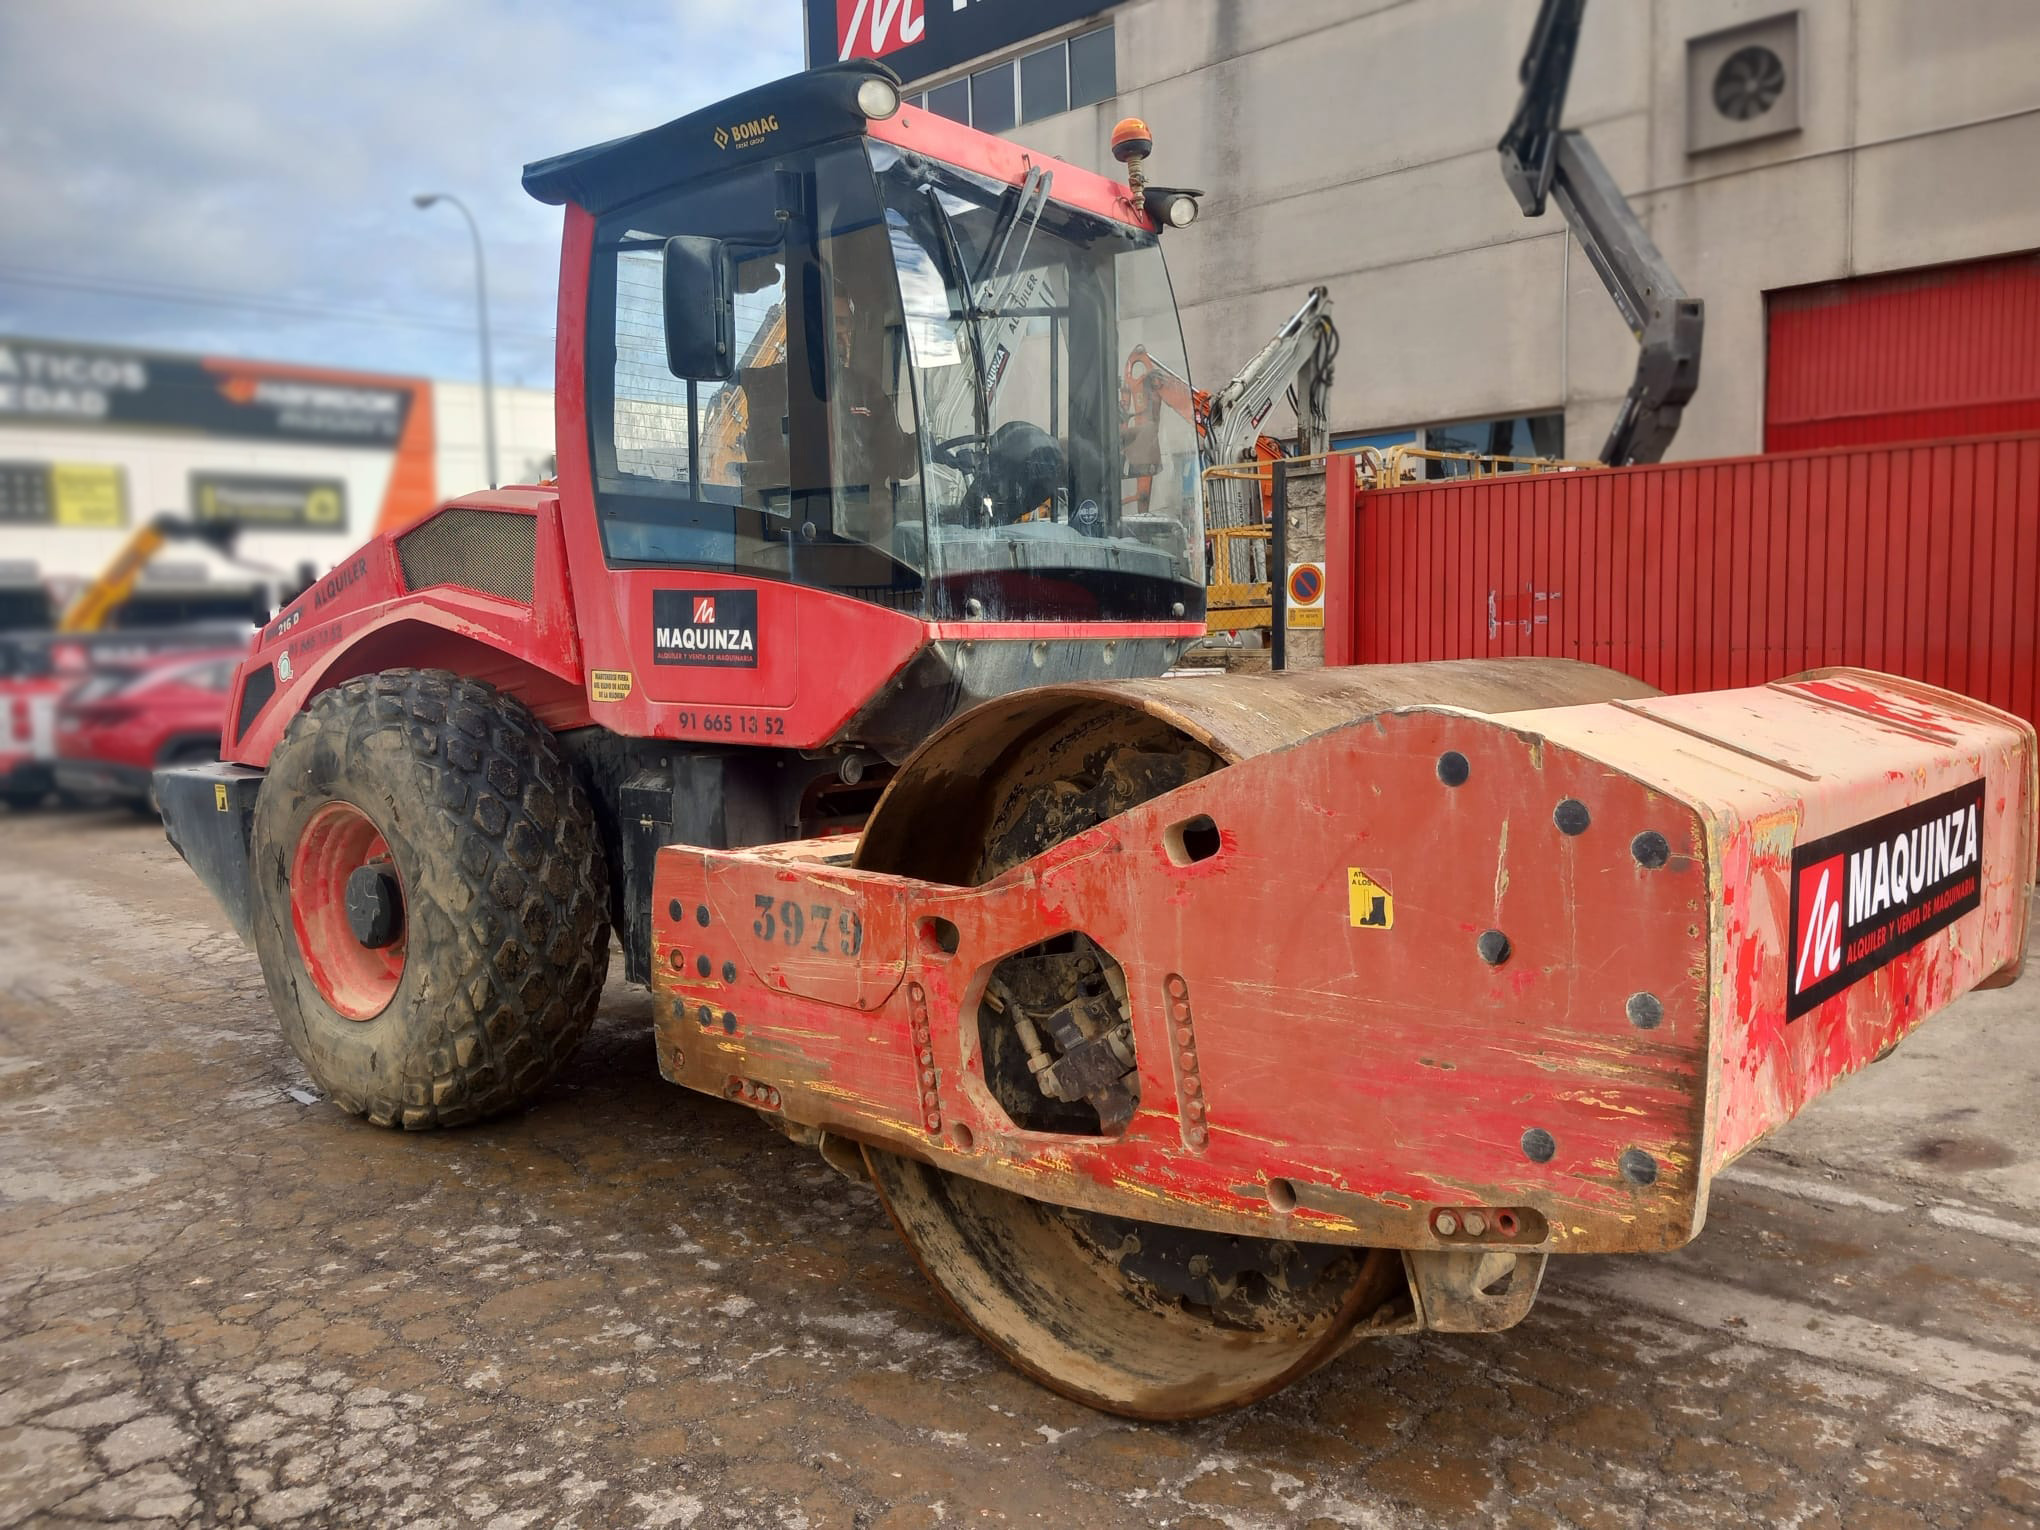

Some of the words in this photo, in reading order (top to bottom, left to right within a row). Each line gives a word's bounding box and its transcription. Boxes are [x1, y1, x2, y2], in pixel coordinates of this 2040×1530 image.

[731, 115, 779, 142] BOMAG
[315, 558, 367, 610] ALQUILER
[278, 616, 292, 636] 216
[293, 612, 300, 626] D
[656, 627, 754, 650] MAQUINZA
[716, 654, 753, 662] MAQUINARIA
[679, 712, 696, 730] 91
[704, 714, 732, 732] 665
[740, 716, 758, 734] 13
[765, 717, 784, 735] 52
[1848, 803, 1977, 928] MAQUINZA
[754, 894, 862, 956] 3979
[1846, 925, 1887, 966] ALQUILER
[1889, 919, 1895, 941] Y
[1897, 906, 1920, 936] VENTA
[1922, 900, 1933, 921] DE
[1933, 875, 1976, 916] MAQUINARIA
